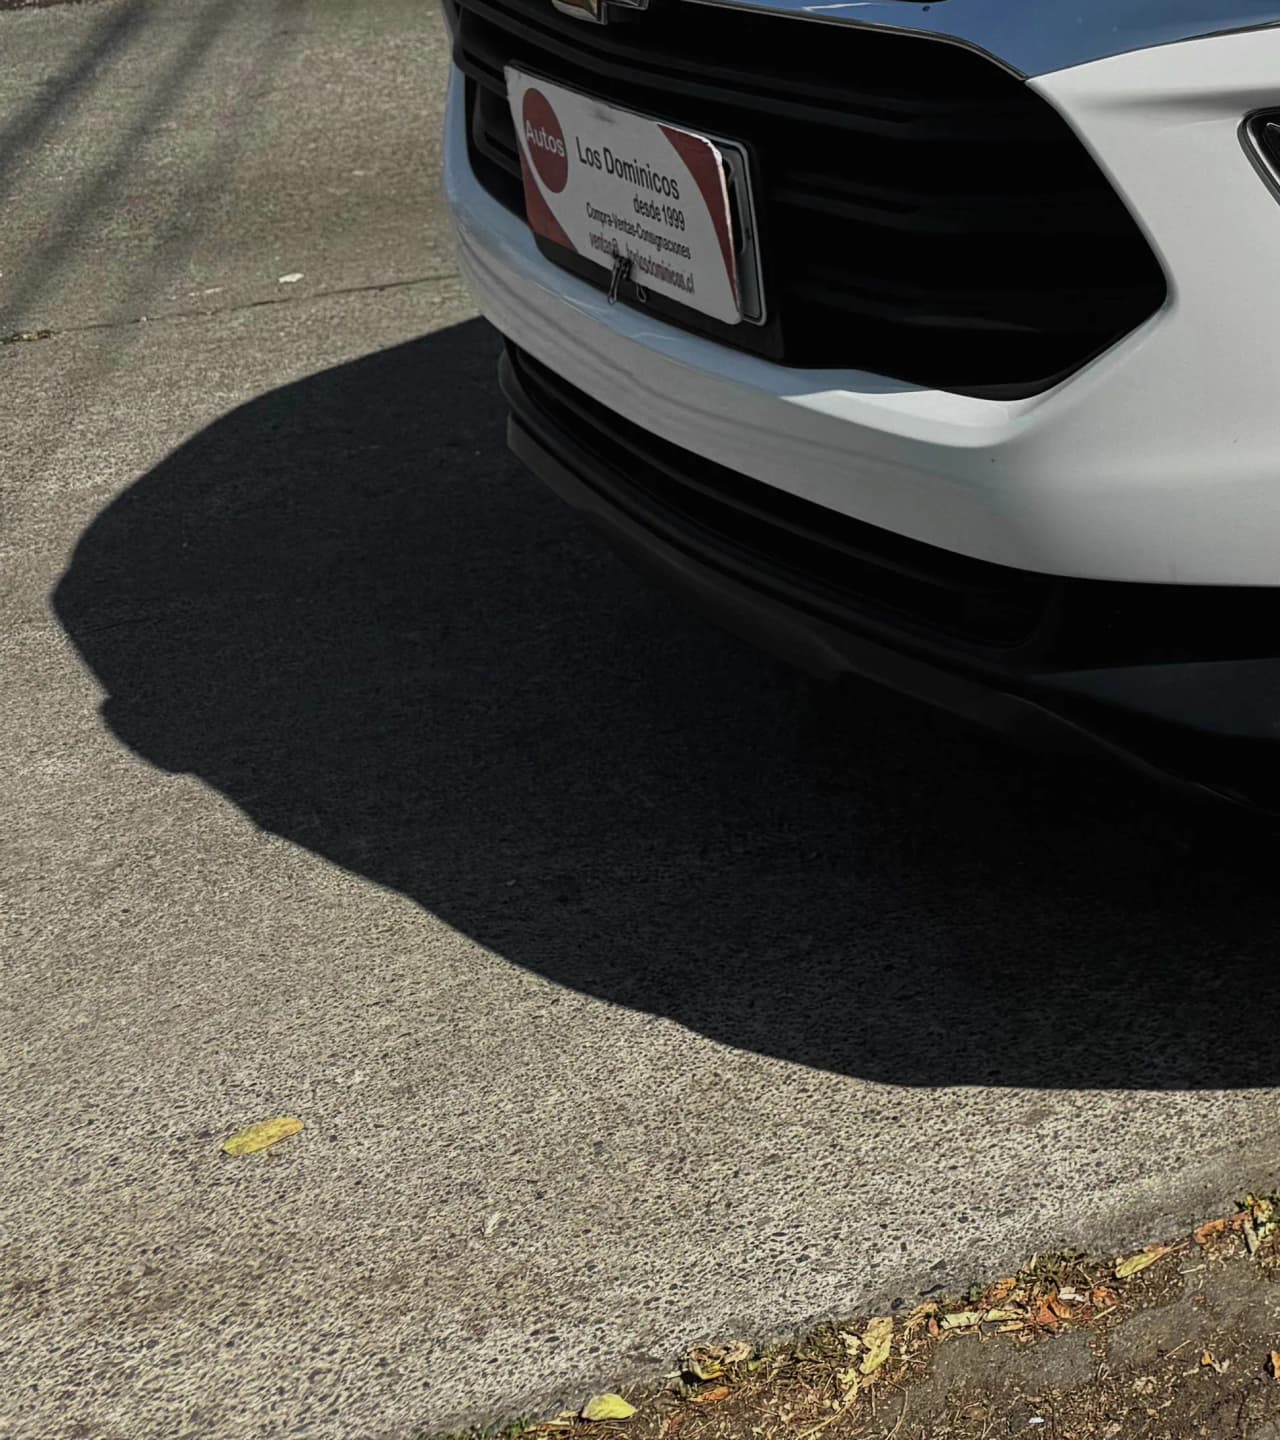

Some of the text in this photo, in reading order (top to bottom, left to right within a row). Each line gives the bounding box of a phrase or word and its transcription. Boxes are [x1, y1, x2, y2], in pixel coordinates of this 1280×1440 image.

[525, 120, 566, 158] Autos
[575, 136, 680, 201] Los Dominicos
[633, 193, 686, 232] desde 1999
